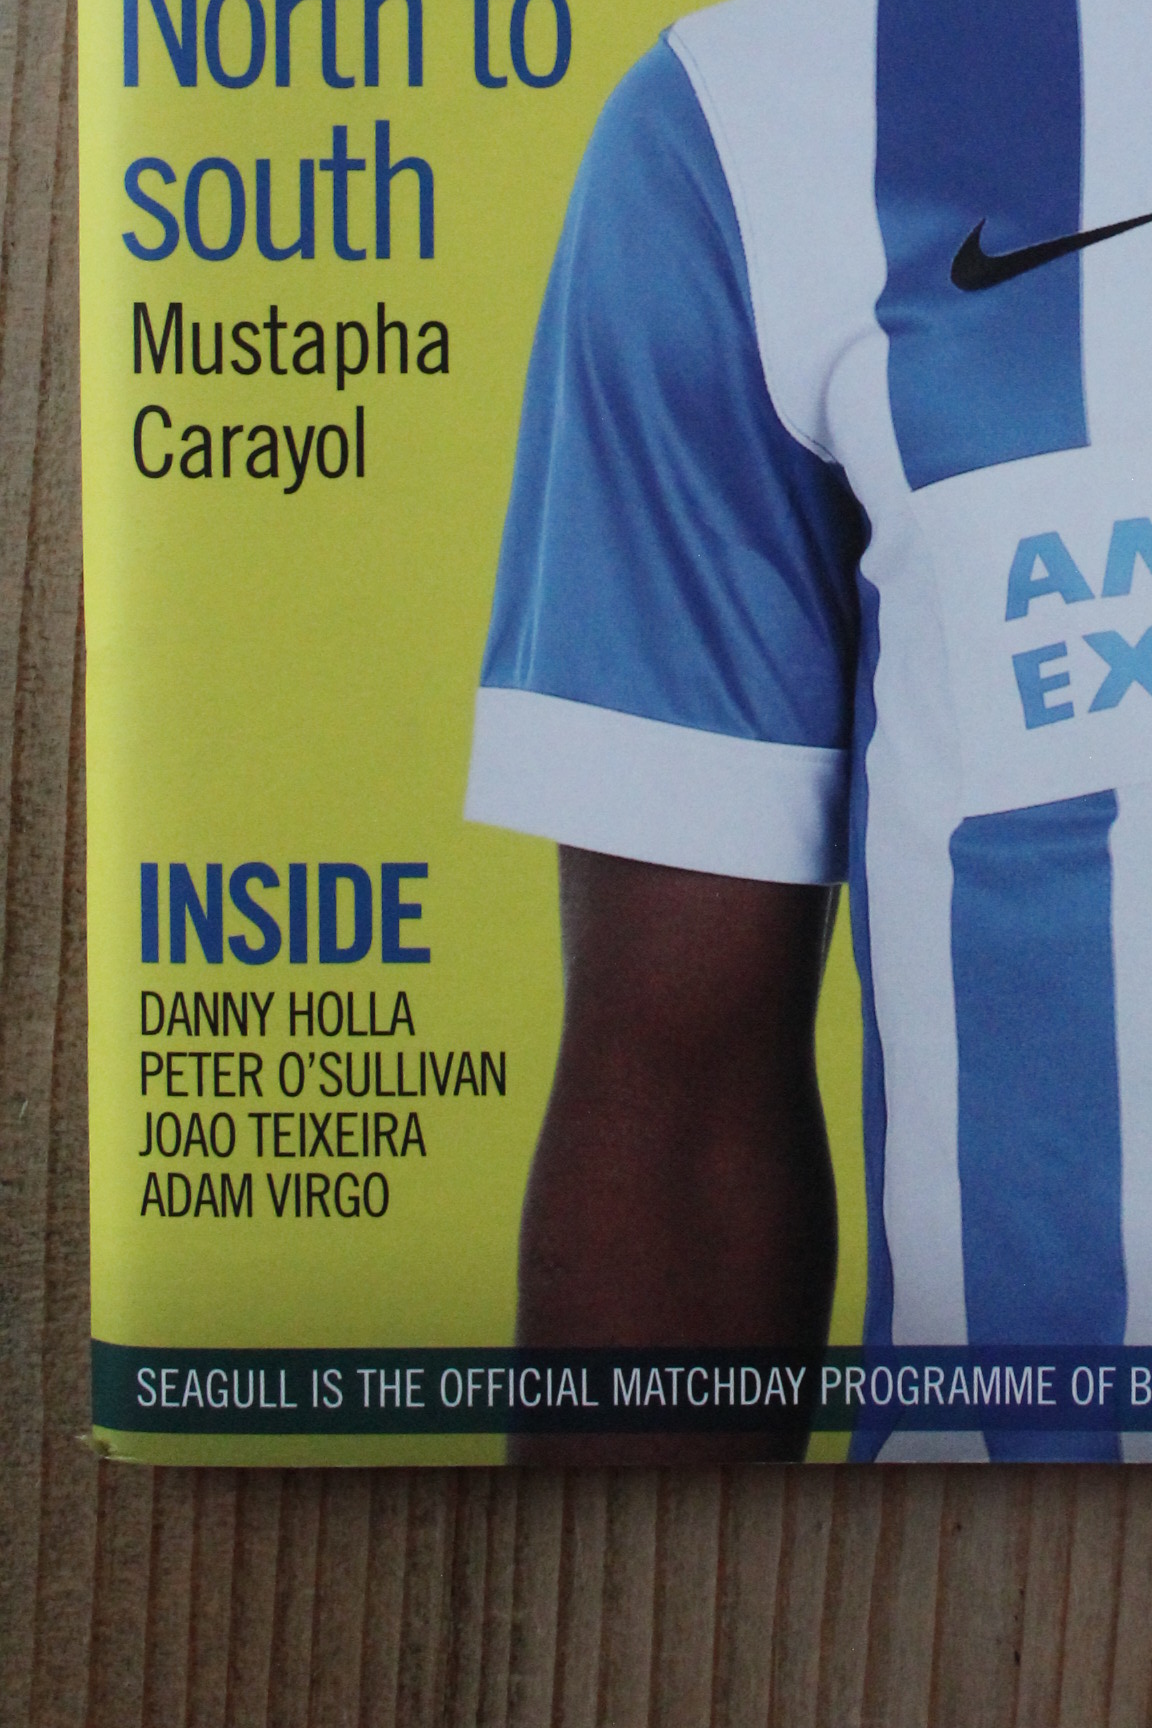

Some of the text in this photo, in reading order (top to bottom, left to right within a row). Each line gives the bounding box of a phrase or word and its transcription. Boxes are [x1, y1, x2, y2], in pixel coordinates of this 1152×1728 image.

[121, 119, 436, 262] south
[132, 301, 450, 391] Mustapha
[132, 404, 366, 495] Carayol
[140, 861, 431, 966] INSIDE
[140, 990, 416, 1037] DANNY HOLLA
[140, 1051, 507, 1098] PETER O'SULLIVAN
[138, 1111, 427, 1158] JOAO TEIXEIRA
[140, 1171, 390, 1218] ADAM VIRGO
[136, 1367, 298, 1409] SEAGULL
[311, 1368, 344, 1408] IS
[357, 1368, 426, 1408] THE
[439, 1367, 600, 1408] OFFICIAL
[611, 1366, 806, 1406] MATCHDAY
[820, 1365, 1057, 1407] PROGRAMME
[1070, 1366, 1117, 1406] OF
